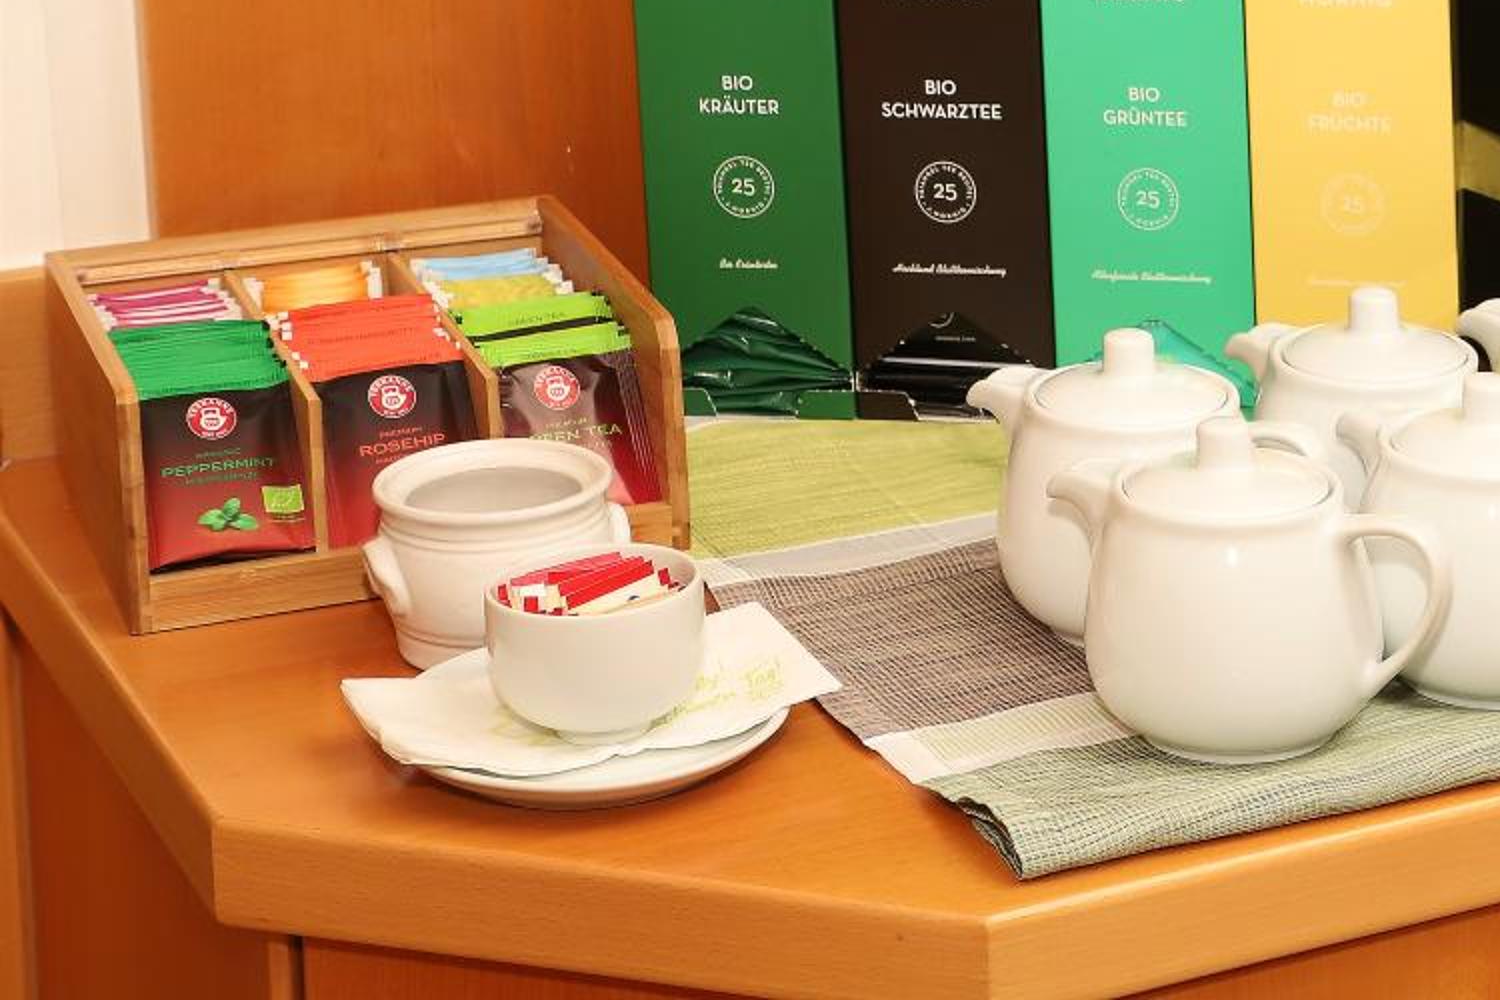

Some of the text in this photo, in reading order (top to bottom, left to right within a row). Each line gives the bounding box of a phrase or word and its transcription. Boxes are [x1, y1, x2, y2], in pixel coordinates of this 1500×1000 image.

[721, 75, 753, 91] BIO
[925, 79, 957, 95] BIO
[1128, 87, 1160, 102] BIO
[699, 96, 779, 115] KRÄUTER
[881, 102, 1003, 120] SCHWARZTEE
[1103, 107, 1188, 127] GRÜNTEE
[731, 178, 756, 197] 25
[932, 183, 958, 202] 25
[1135, 190, 1161, 209] 25
[359, 433, 446, 457] ROSEHIP
[160, 457, 274, 478] PEPPERMINT
